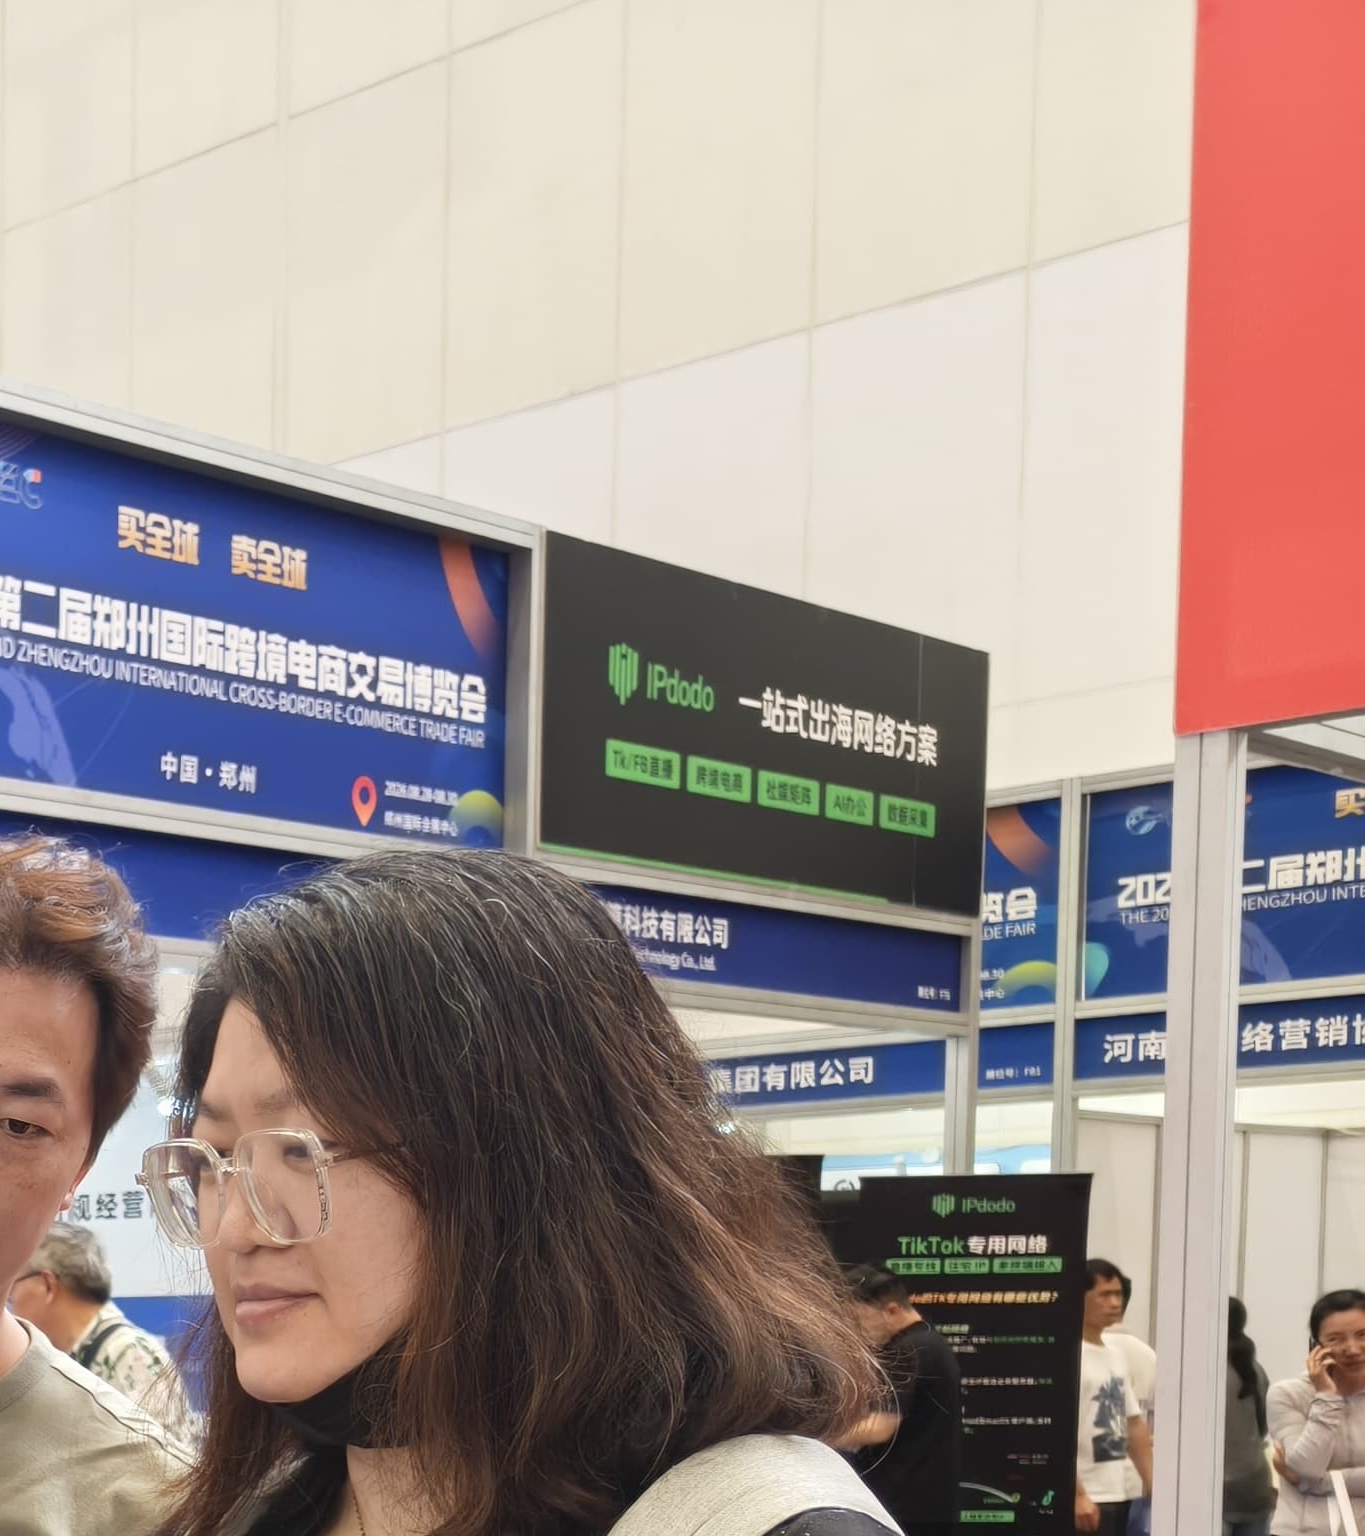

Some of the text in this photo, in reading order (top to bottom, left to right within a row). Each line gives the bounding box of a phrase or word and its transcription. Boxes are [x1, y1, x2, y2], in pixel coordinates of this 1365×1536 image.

[117, 505, 308, 592] 买全球 卖全球
[17, 640, 113, 680] ZHENGZHOU
[115, 658, 227, 701] INTERNATIONAL
[229, 682, 333, 722] CROSS-BORDER
[333, 700, 417, 737] E-COMMERCE
[418, 717, 458, 744] TRADE
[458, 727, 486, 749] FAIR
[645, 661, 716, 713] IPdodo
[737, 685, 939, 767] 一站式出海网络方案
[1005, 922, 1037, 939] FAIR
[1120, 908, 1150, 925] THE
[961, 1196, 1017, 1214] IPdodo
